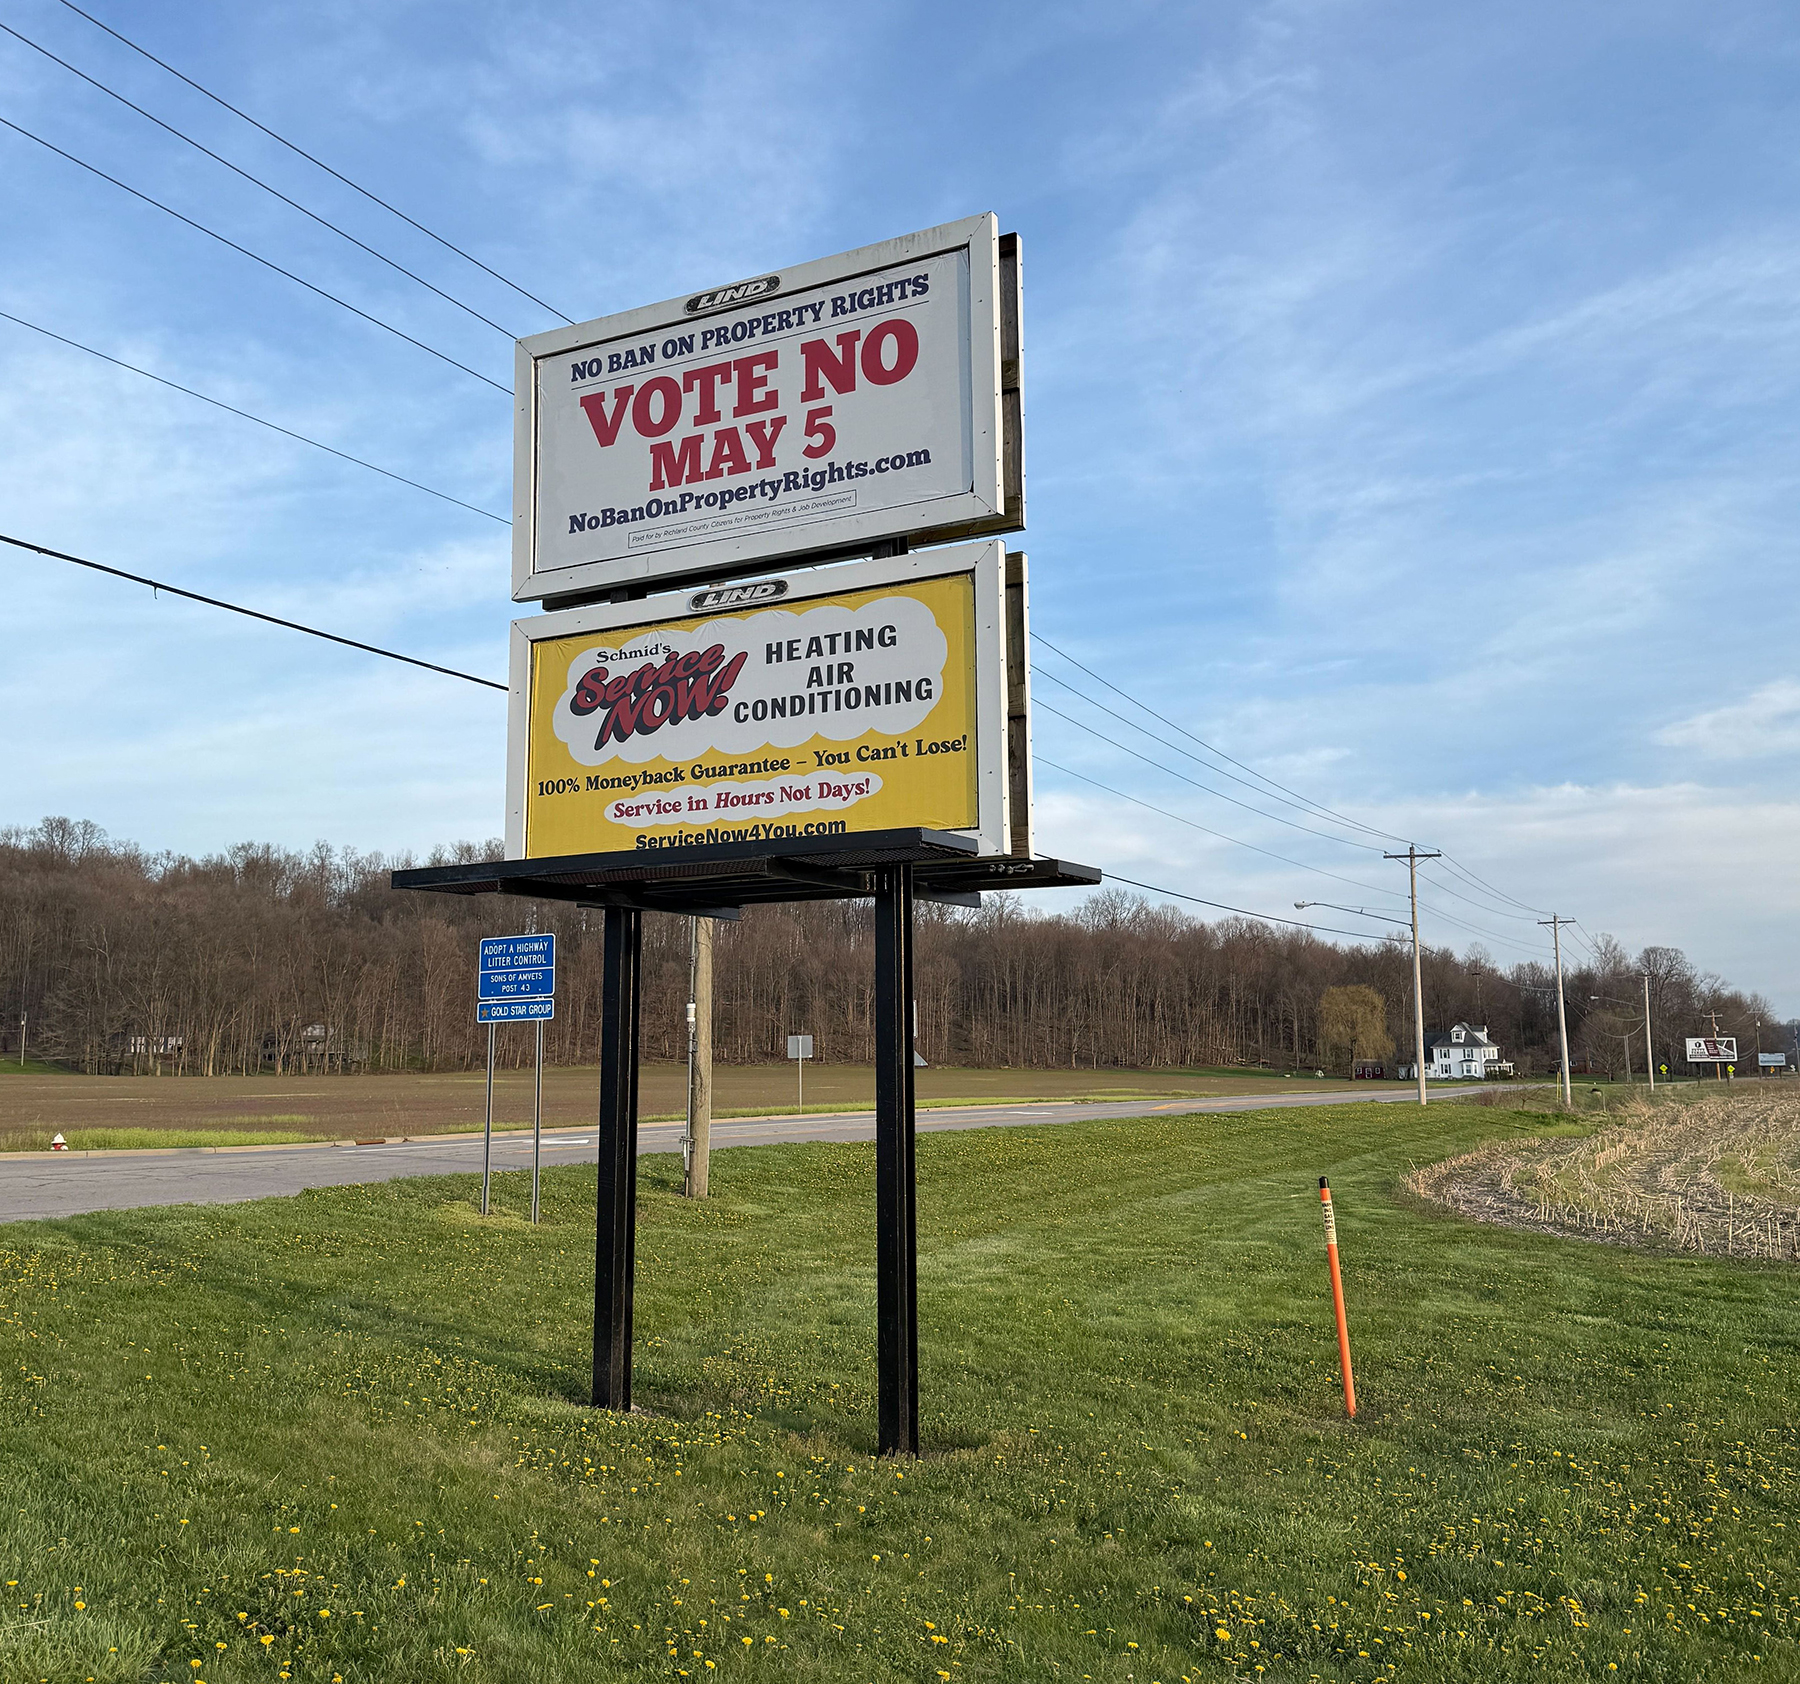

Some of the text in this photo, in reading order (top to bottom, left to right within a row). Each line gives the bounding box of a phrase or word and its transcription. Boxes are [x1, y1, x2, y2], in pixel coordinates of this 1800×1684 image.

[697, 279, 768, 309] LIND
[571, 273, 929, 383] NO BAN ON PROPERTY RIGHTS
[580, 319, 919, 447] VOTE NO
[649, 405, 836, 492] MAY 5
[568, 449, 931, 534] NoBanOnPropertyRights.com
[632, 534, 645, 543] Paid
[655, 531, 662, 539] by
[664, 526, 688, 536] Richland
[689, 523, 709, 533] County
[711, 518, 733, 528] Citizens
[734, 516, 743, 524] for
[744, 511, 771, 522] Property
[772, 507, 791, 517] Rights
[791, 505, 797, 513] &
[798, 503, 811, 512] Job
[811, 496, 852, 509] Development
[702, 583, 776, 607] LIND
[596, 643, 672, 663] Schmid's
[765, 624, 897, 664] HEATING
[570, 644, 725, 716] Service
[806, 662, 854, 689] AIR
[594, 651, 748, 750] NOW!
[734, 677, 933, 723] CONDITIONING
[538, 777, 580, 796] 100%
[585, 767, 685, 791] Moneyback
[690, 757, 790, 780] Guarantee
[813, 749, 850, 767] You
[856, 740, 909, 762] Can’t
[915, 734, 968, 757] Lose!
[613, 778, 870, 819] Service in Hours Not Days!
[635, 819, 847, 850] ServiceNow4You.com
[484, 941, 549, 955] ADOPT A HIGHWAY
[488, 954, 546, 967] LITTER CONTROL
[490, 974, 507, 983] SONS
[508, 973, 516, 981] OF
[501, 984, 517, 993] POST
[491, 1004, 552, 1017] GOLD STAR GROUP
